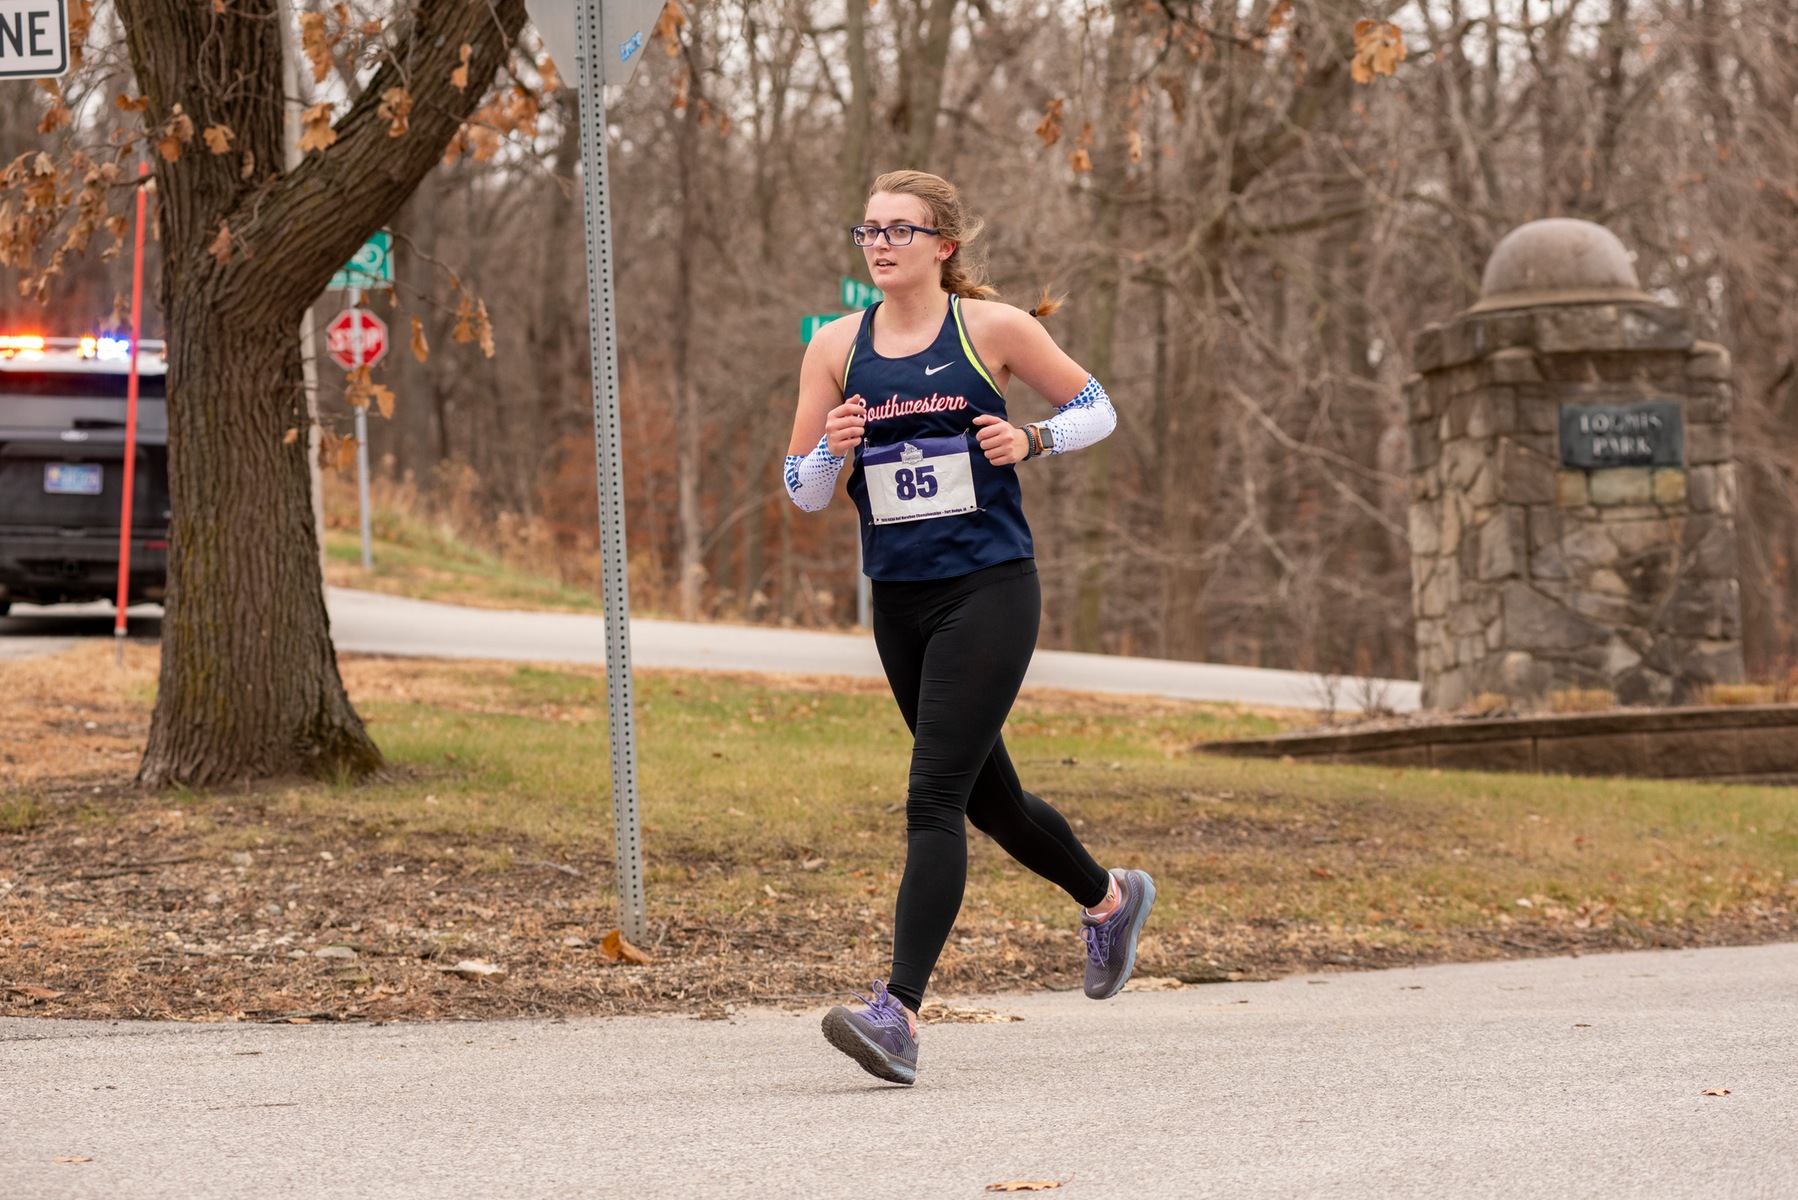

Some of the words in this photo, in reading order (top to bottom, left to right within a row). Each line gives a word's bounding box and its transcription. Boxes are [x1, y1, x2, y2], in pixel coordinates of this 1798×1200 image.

[858, 392, 968, 422] Southwestern
[1592, 435, 1652, 457] PARK
[895, 465, 938, 501] 85
